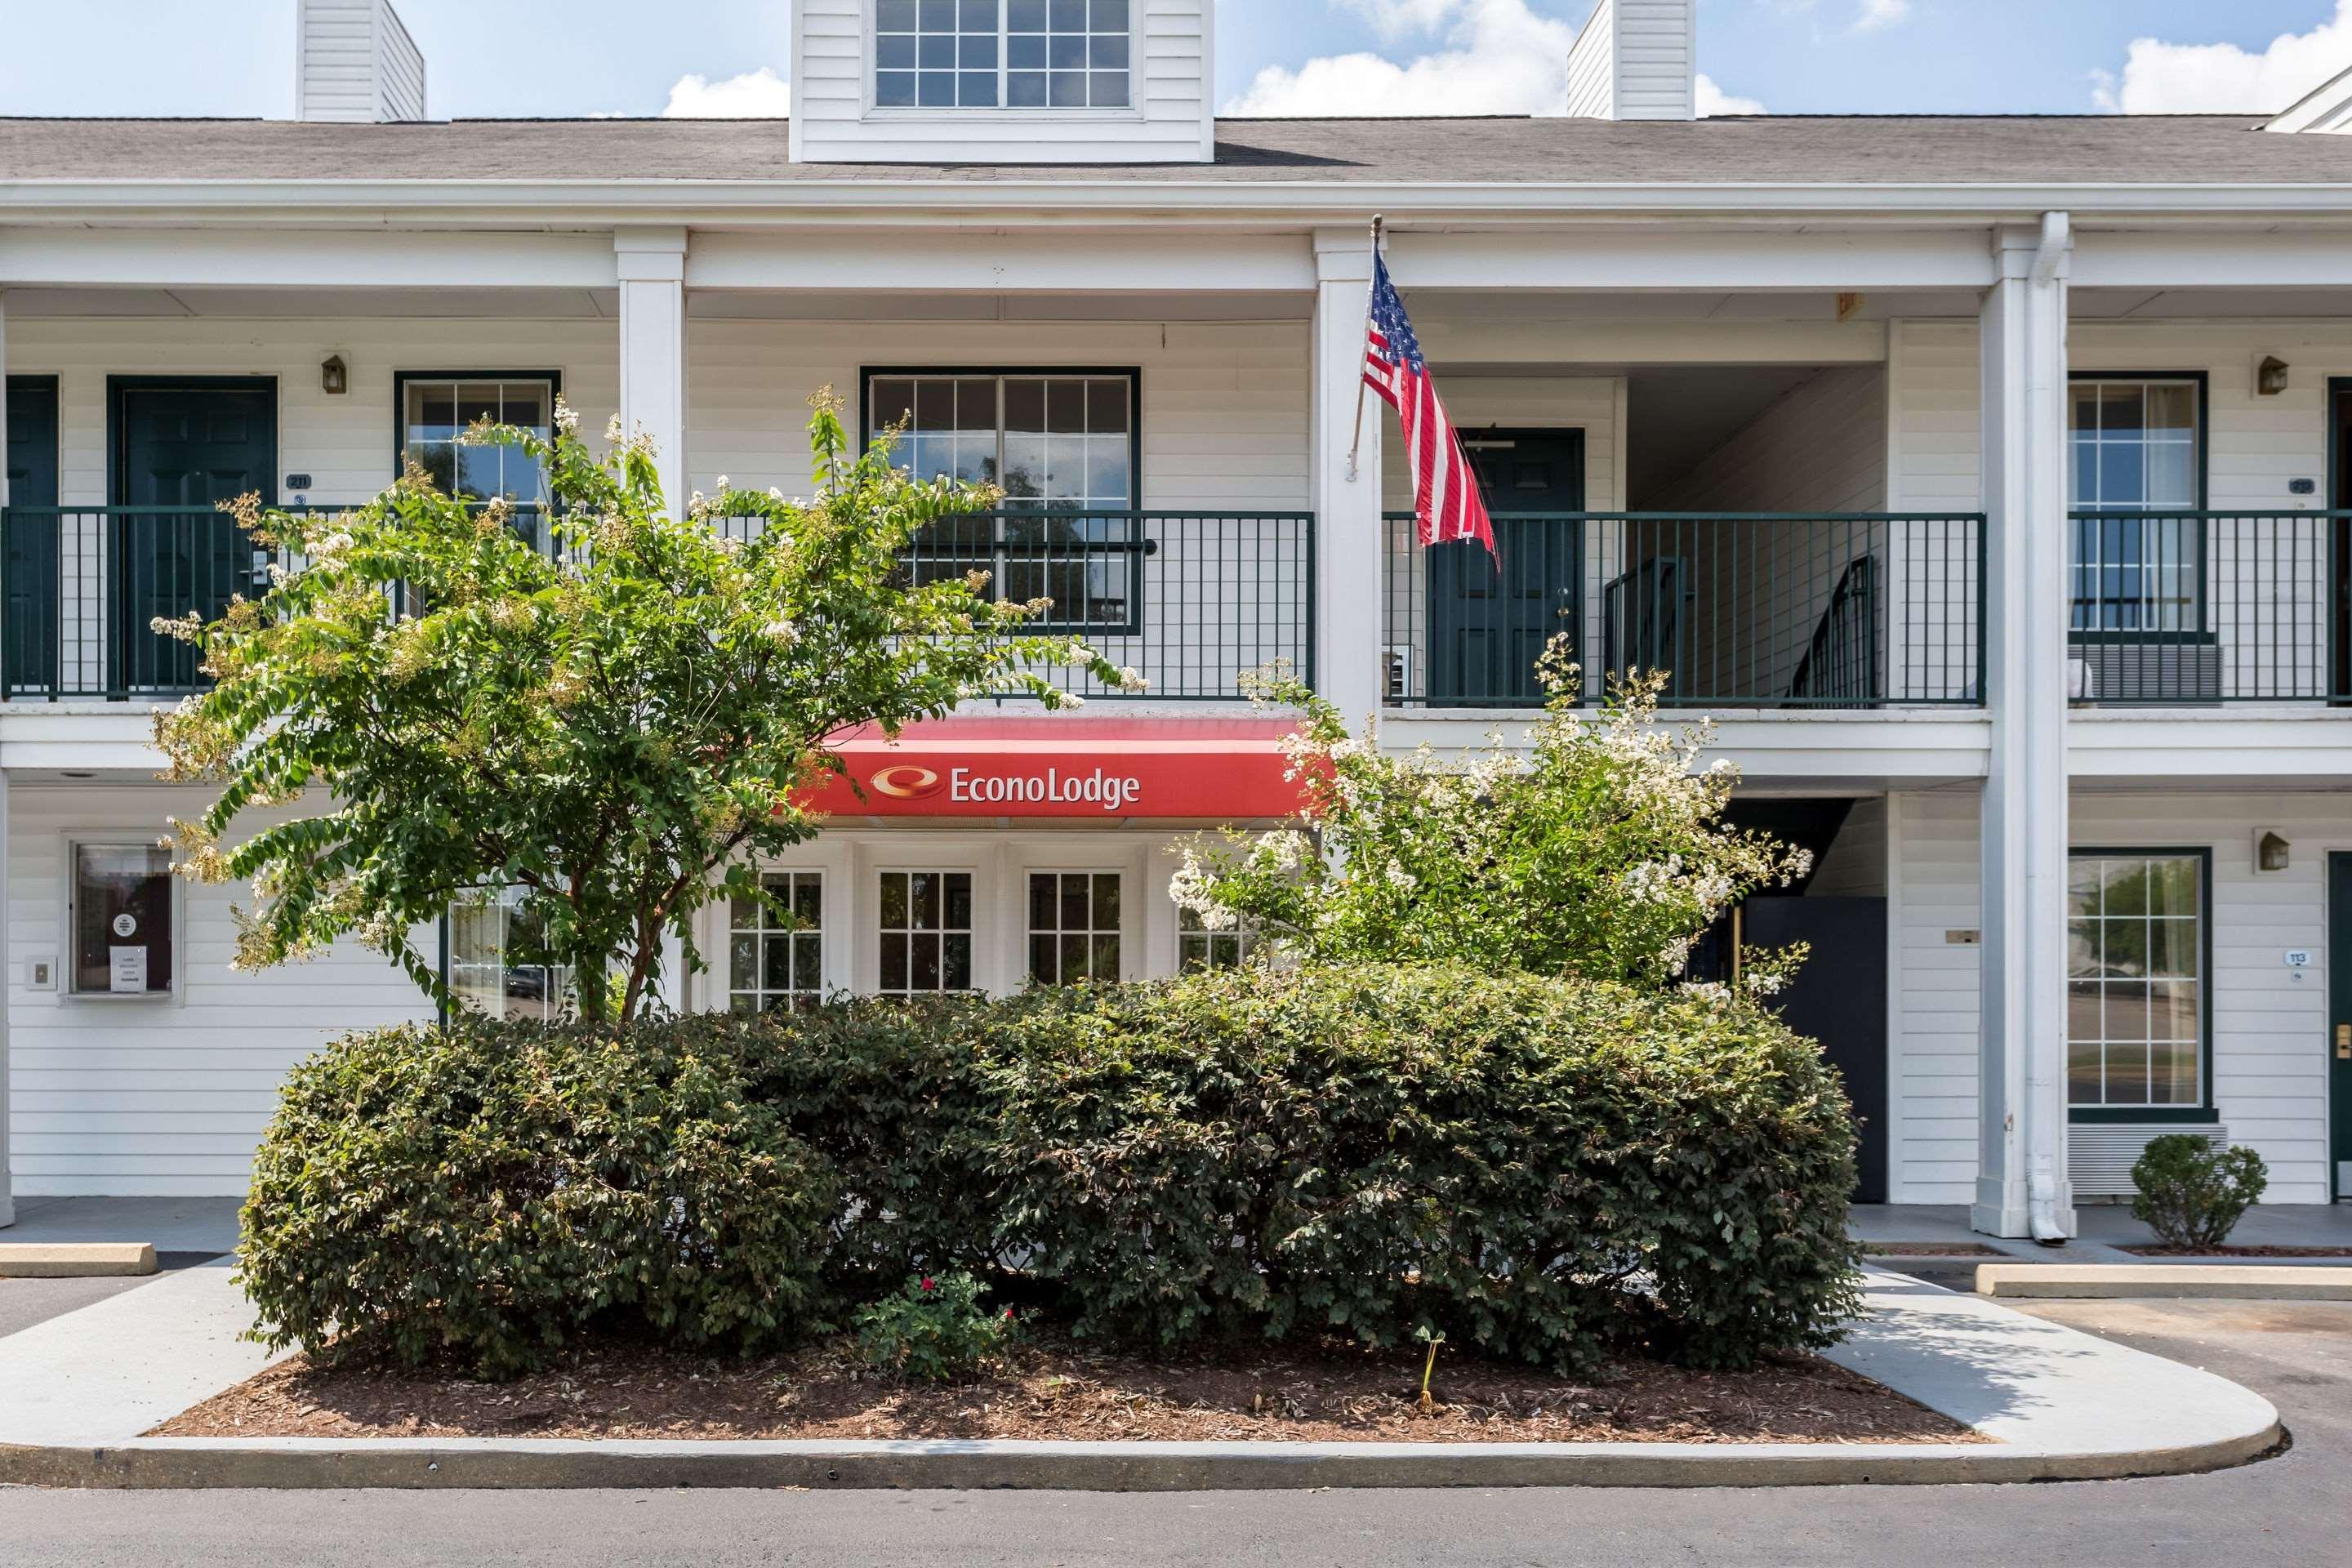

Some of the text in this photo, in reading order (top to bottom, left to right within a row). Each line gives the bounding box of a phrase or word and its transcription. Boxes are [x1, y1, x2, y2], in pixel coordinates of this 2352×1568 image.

[291, 476, 307, 487] 211
[951, 768, 1140, 810] EconoLodge
[2290, 953, 2306, 963] 113
